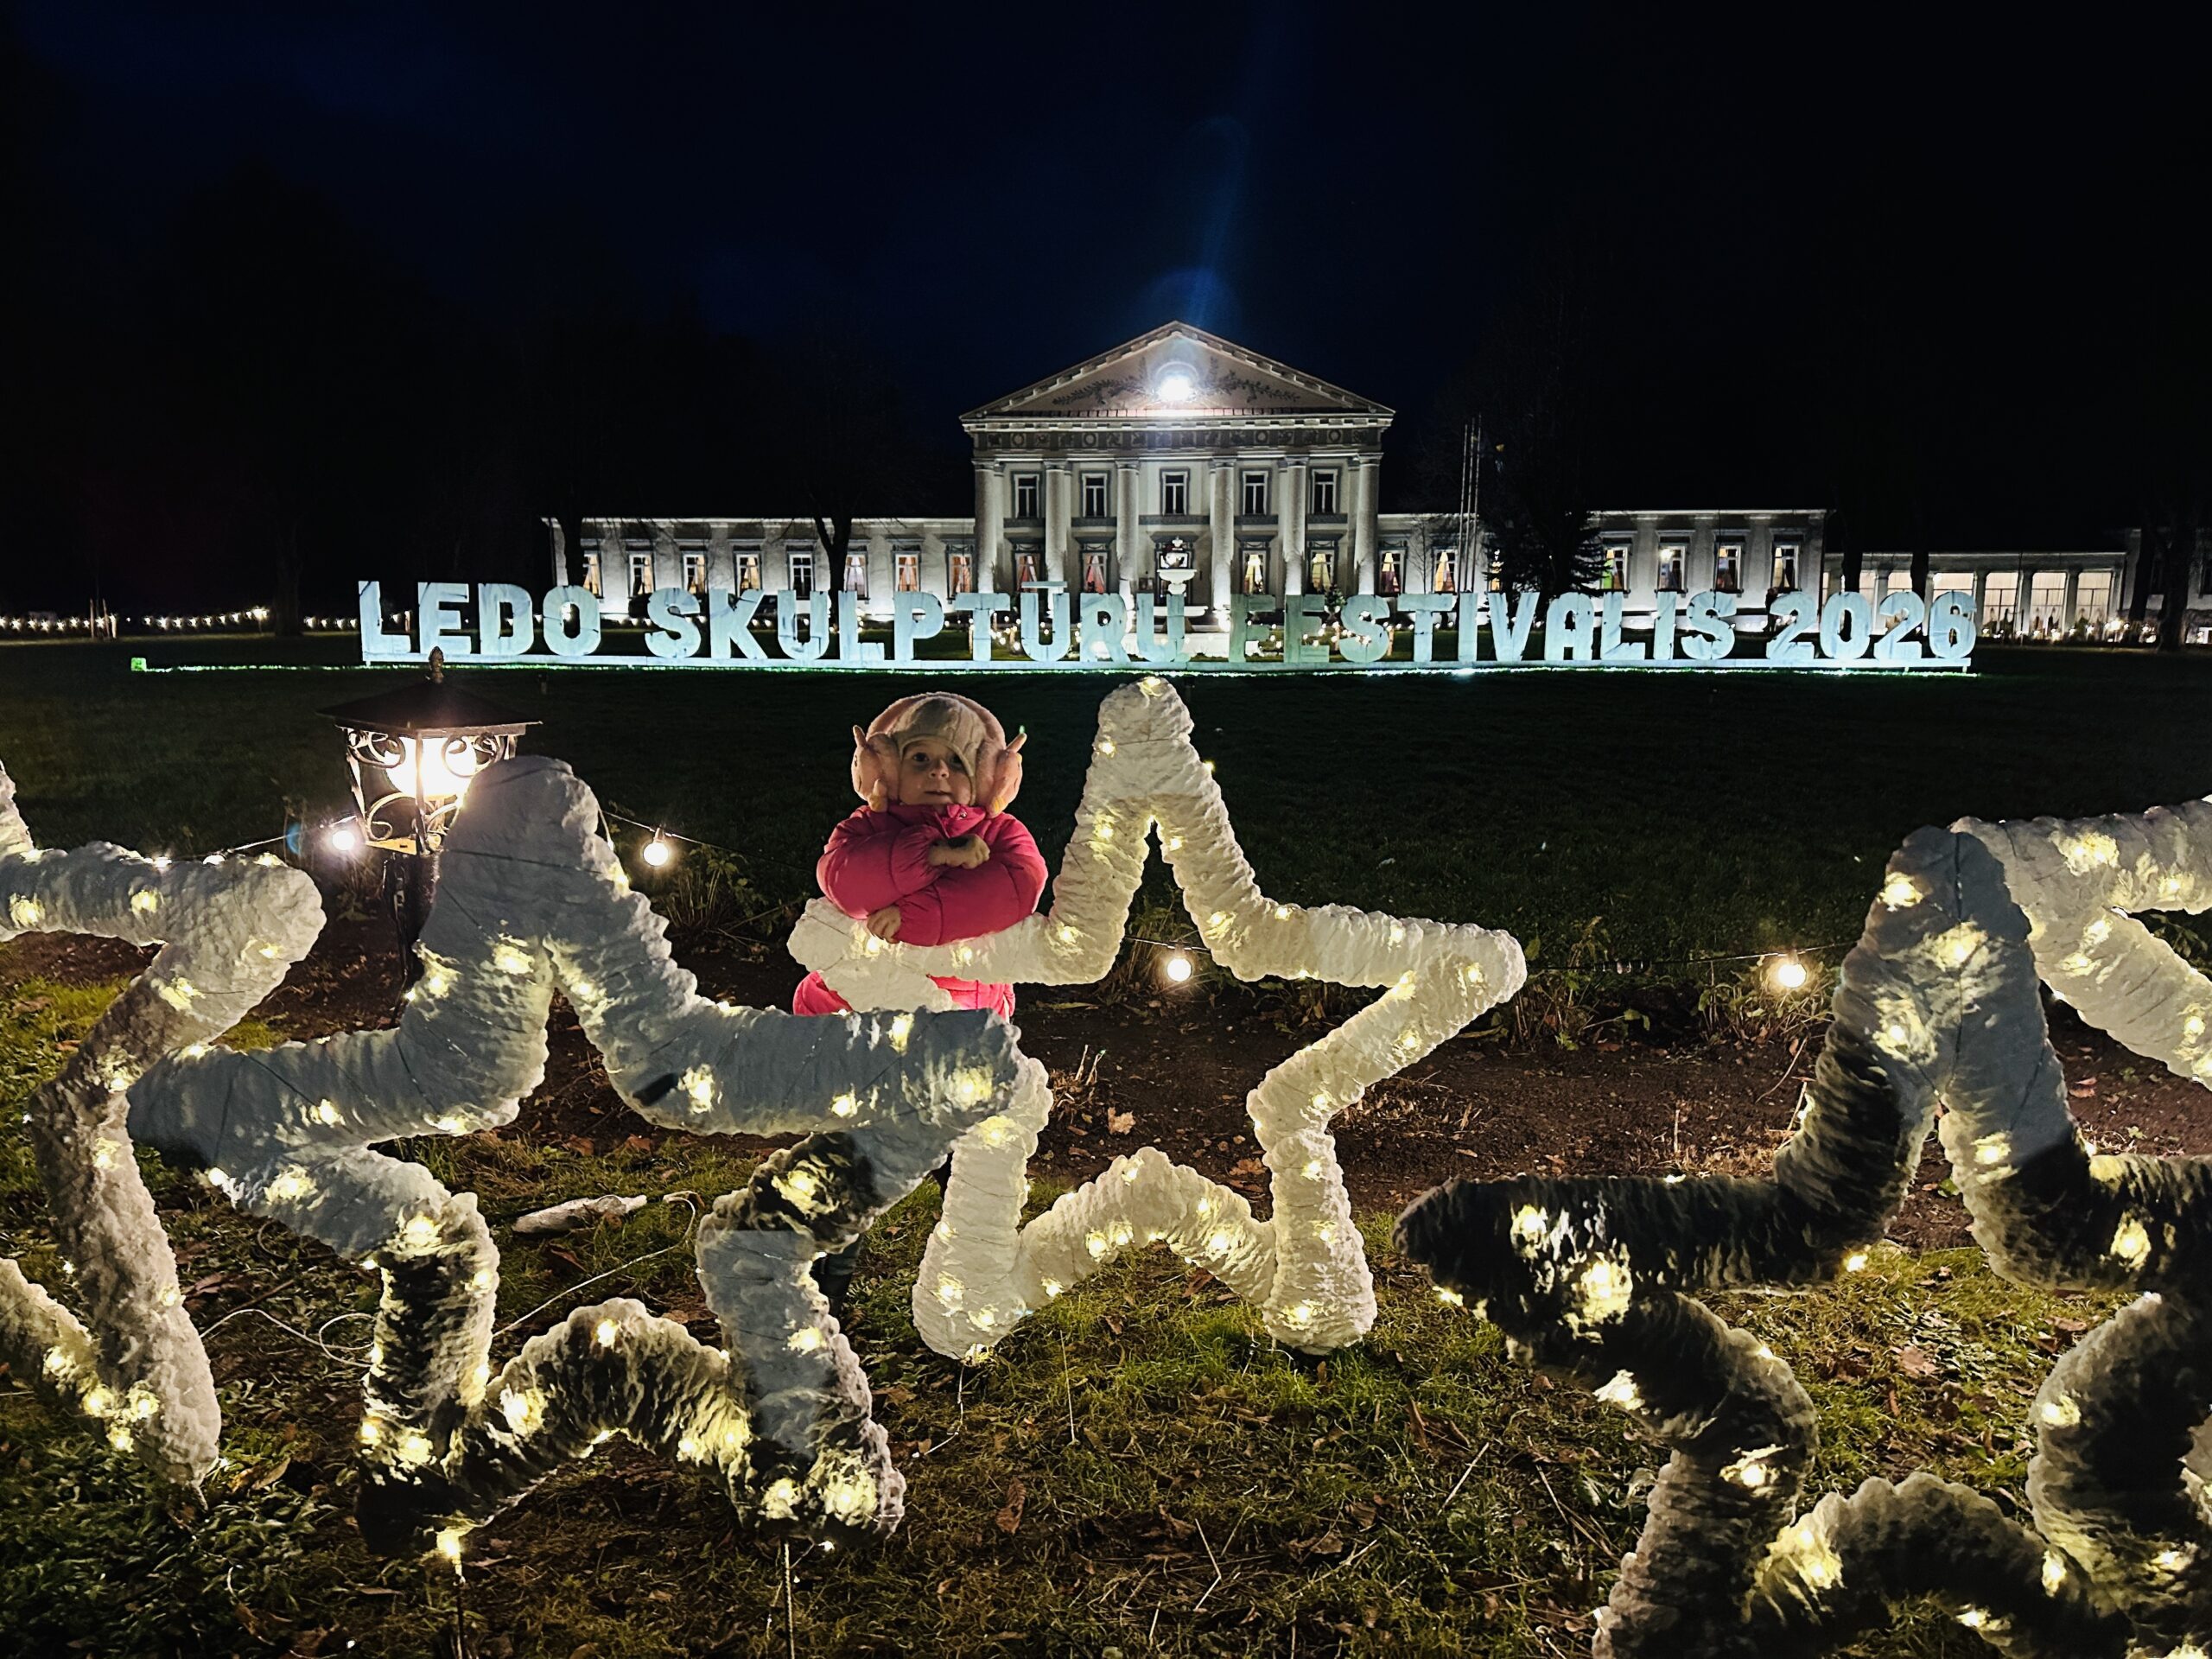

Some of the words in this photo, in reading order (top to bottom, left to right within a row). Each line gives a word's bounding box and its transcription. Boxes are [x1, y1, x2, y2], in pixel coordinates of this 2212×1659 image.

[358, 581, 601, 656] LEDO
[1227, 592, 1737, 663] FESTIVALIS
[1765, 591, 1977, 659] 2026
